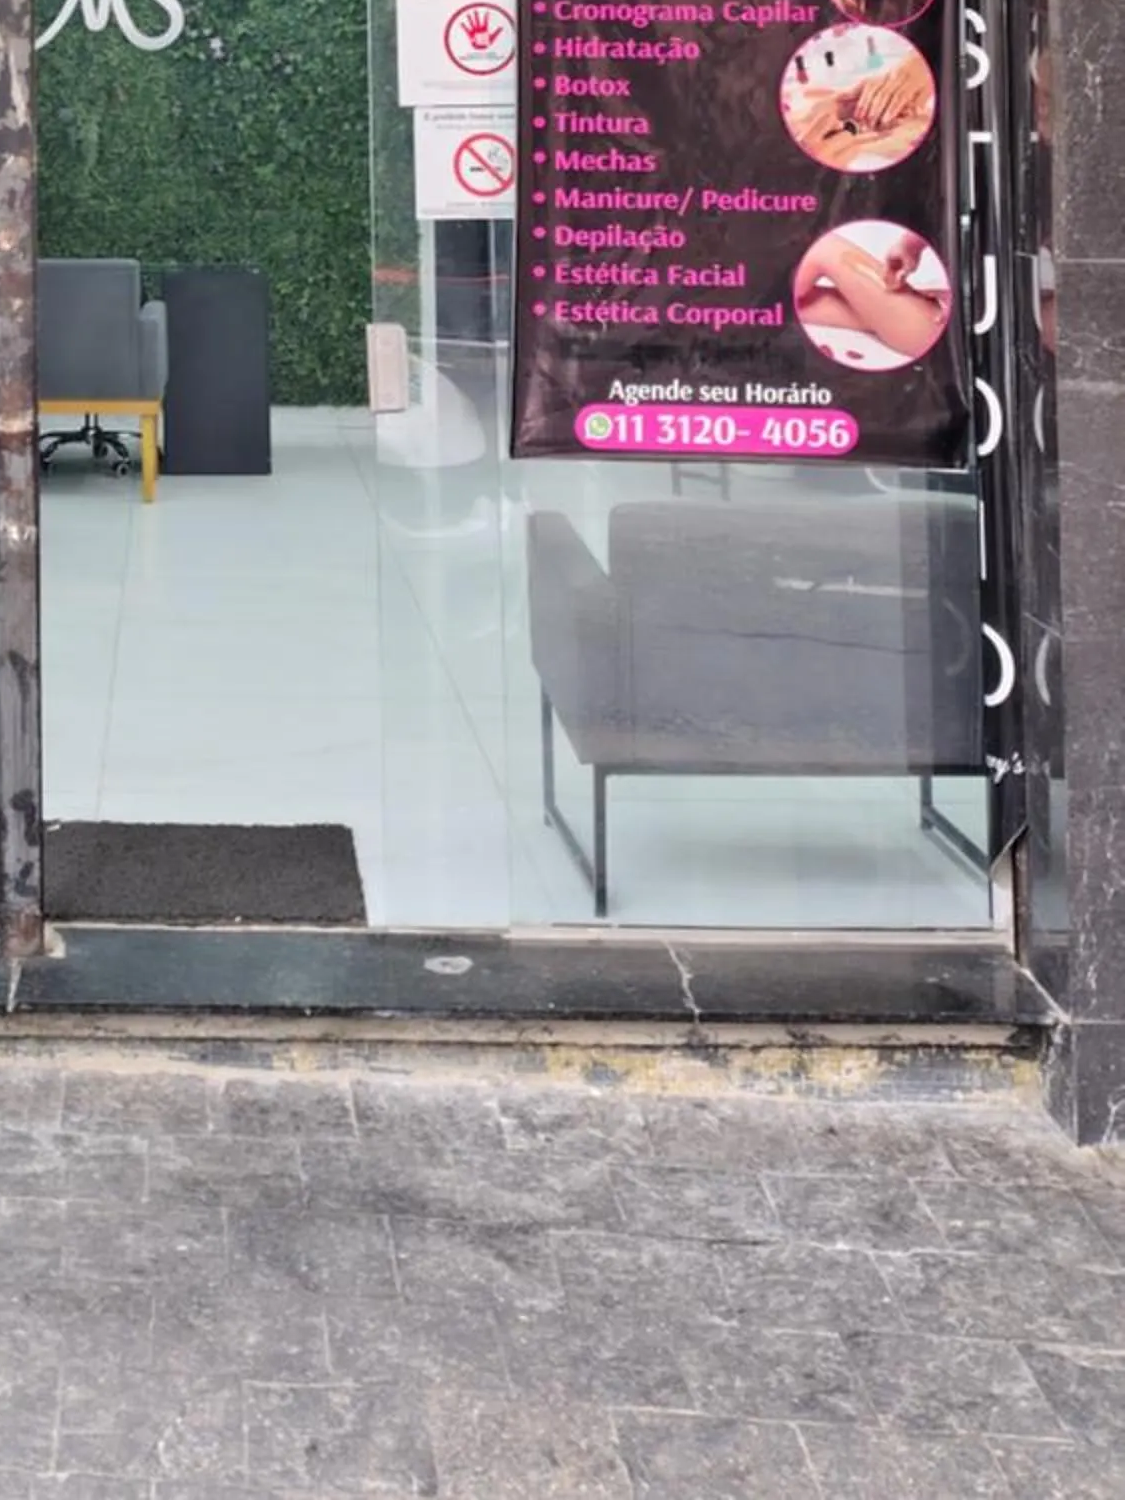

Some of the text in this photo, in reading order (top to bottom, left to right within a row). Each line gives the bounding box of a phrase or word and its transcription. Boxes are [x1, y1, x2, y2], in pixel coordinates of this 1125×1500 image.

[553, 0, 819, 28] Cronograma Capilar
[554, 36, 700, 64] Hidratação
[553, 75, 630, 96] Botox
[555, 112, 649, 134] Tintura
[554, 149, 657, 171] Mechas
[701, 188, 817, 212] Pedicure
[554, 224, 685, 251] Depilação
[554, 263, 746, 287] Estética Facial
[554, 300, 784, 331] Estética Corporal
[609, 379, 832, 406] Agende seu Horário
[615, 414, 644, 443] 11
[763, 419, 849, 446] 4056
